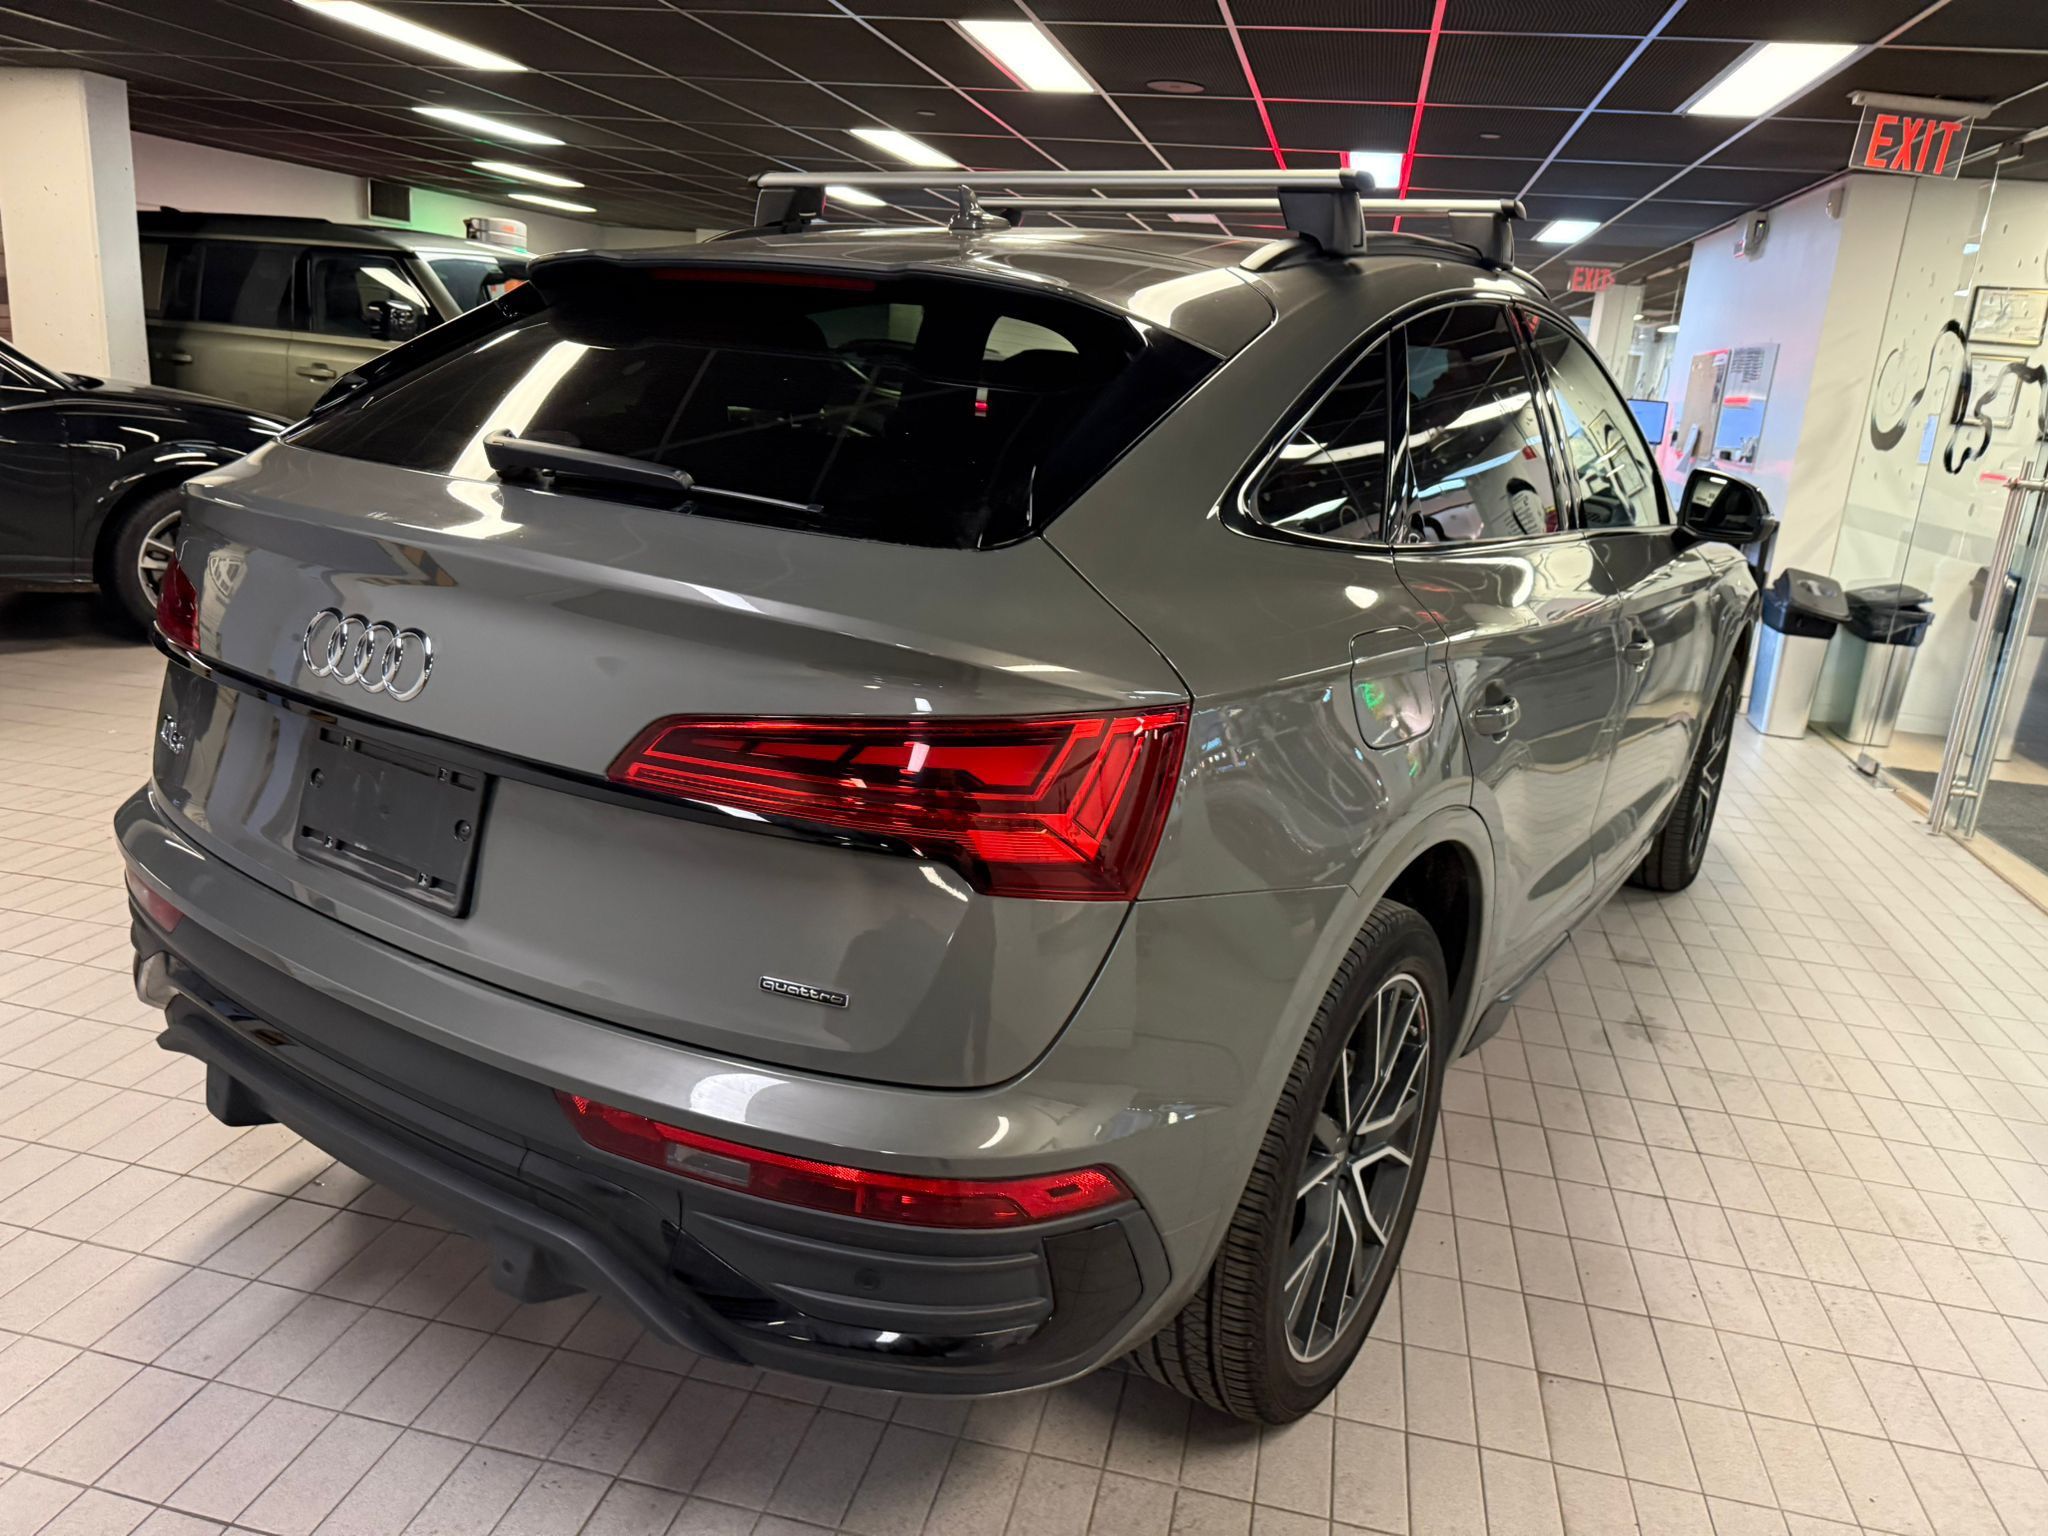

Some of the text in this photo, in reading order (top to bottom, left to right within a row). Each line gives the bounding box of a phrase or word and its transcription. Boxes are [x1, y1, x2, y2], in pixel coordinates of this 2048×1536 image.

[1864, 114, 1963, 175] EXIT
[1572, 266, 1612, 292] EXIT
[762, 979, 843, 1004] quattro
